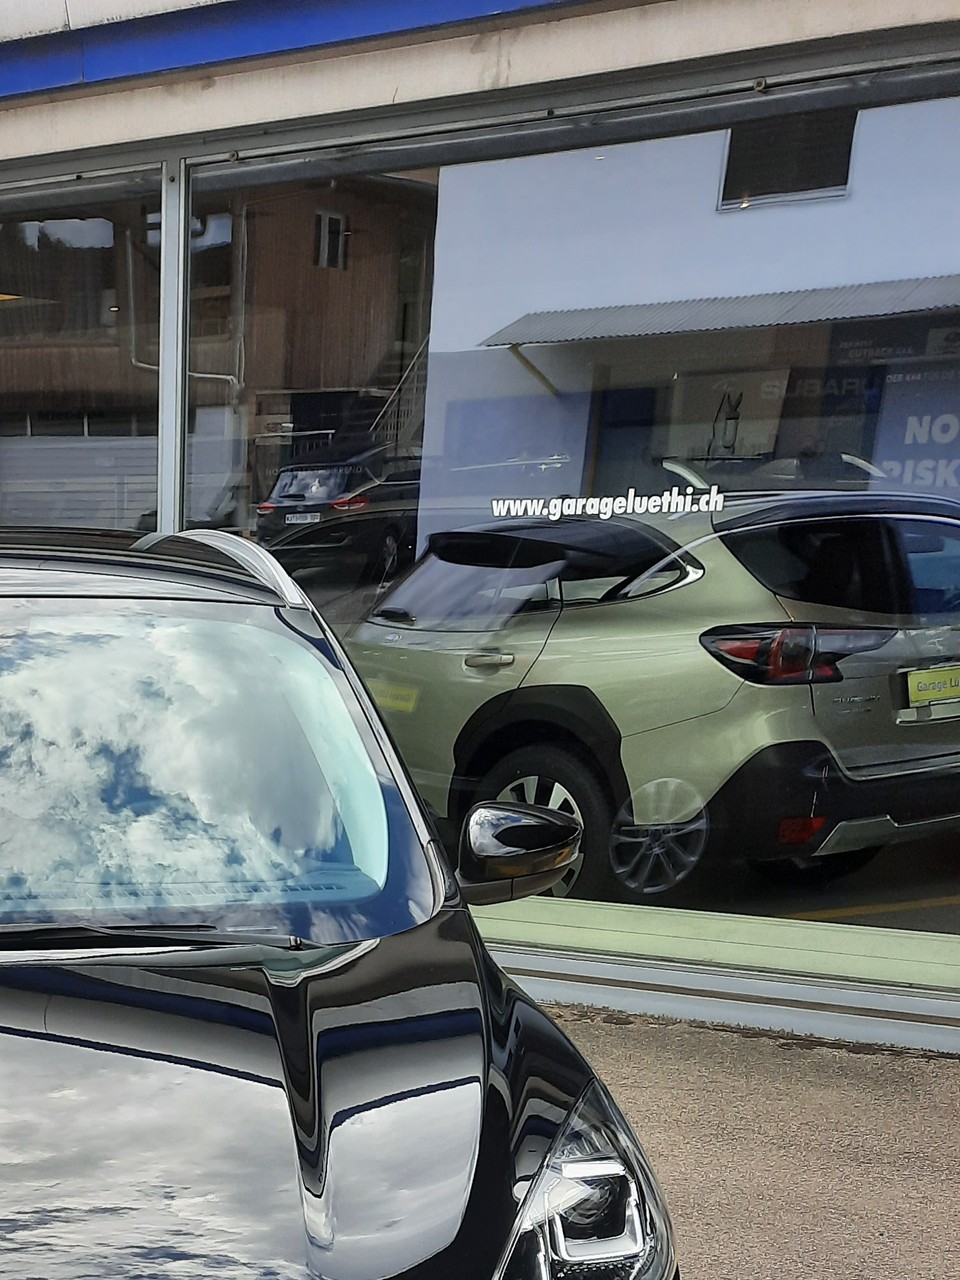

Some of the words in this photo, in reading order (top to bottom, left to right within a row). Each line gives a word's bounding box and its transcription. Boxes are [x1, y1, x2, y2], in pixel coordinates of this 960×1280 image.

[904, 414, 960, 445] NO
[491, 485, 725, 521] www.garageluethi.ch
[917, 679, 948, 692] Garage
